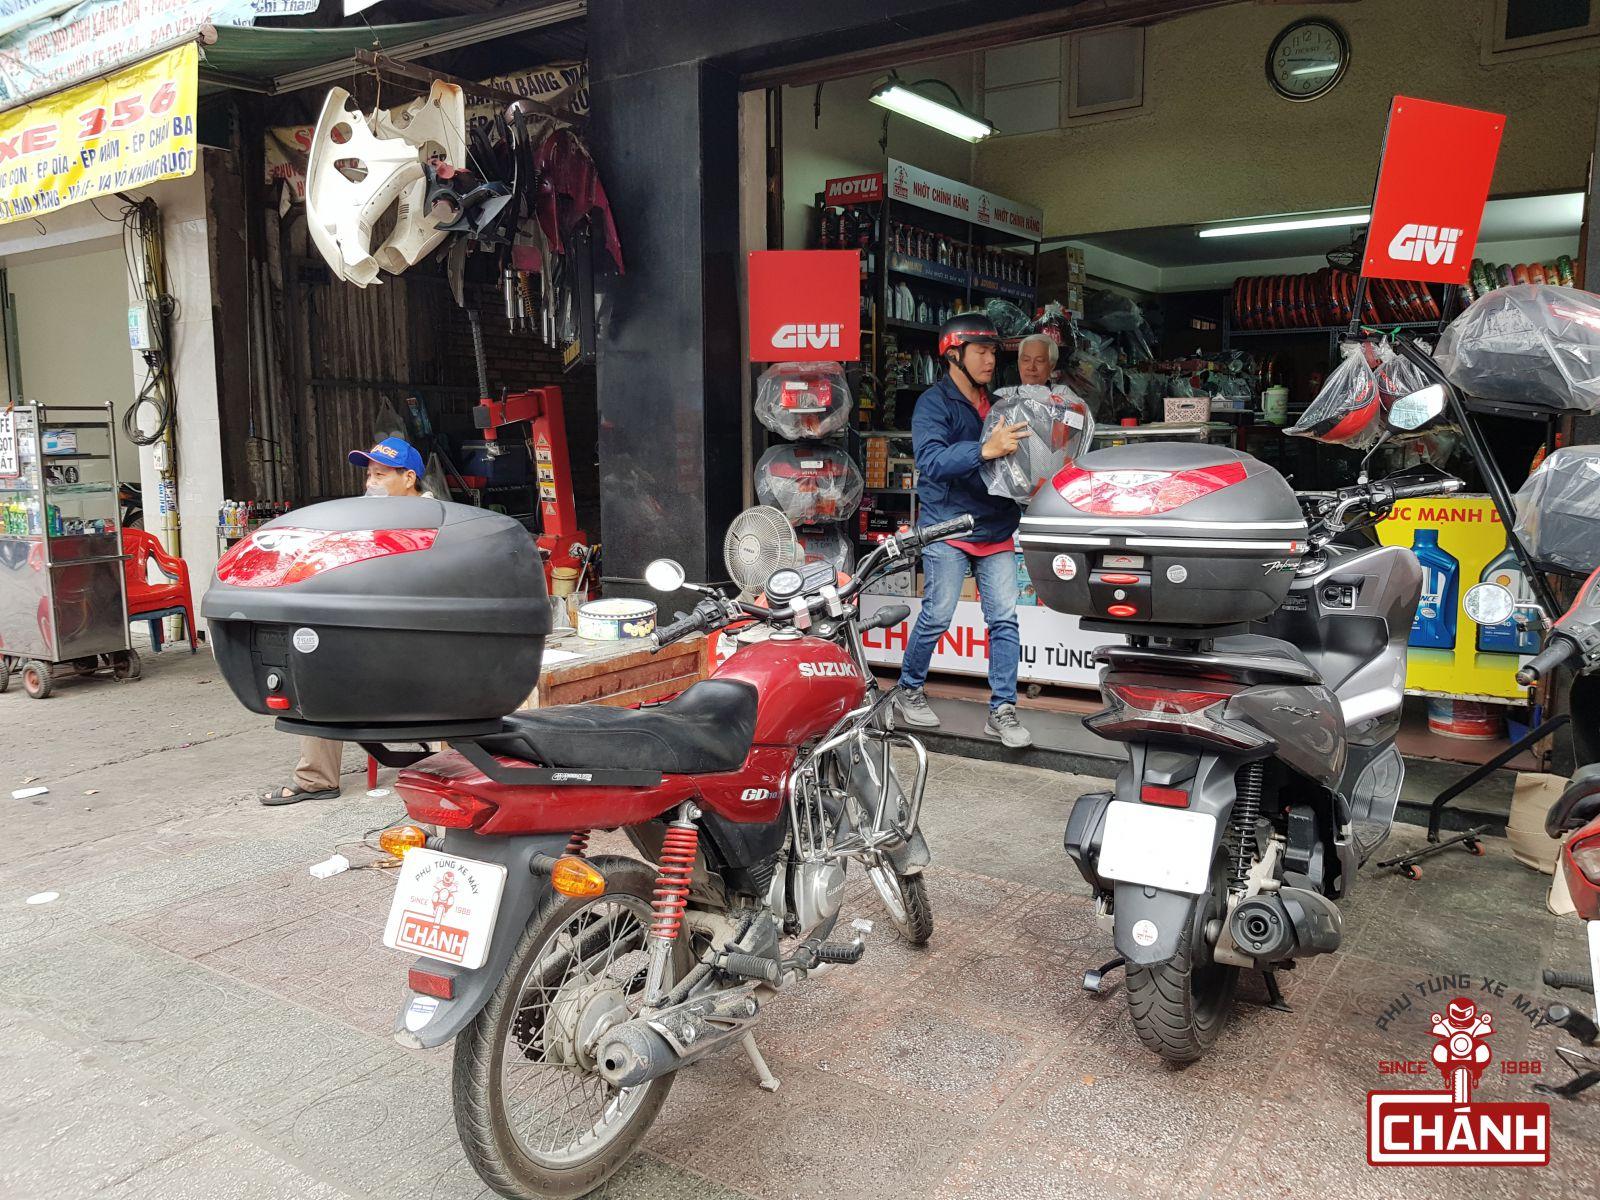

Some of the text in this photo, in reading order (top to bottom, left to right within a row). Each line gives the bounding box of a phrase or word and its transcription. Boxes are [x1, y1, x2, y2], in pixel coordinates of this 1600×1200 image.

[516, 72, 561, 97] BĂNG
[78, 82, 177, 139] 356
[173, 115, 193, 136] BA
[160, 147, 193, 176] RUỘT
[829, 178, 879, 197] MOTUL
[932, 188, 952, 206] CHÍNH
[1387, 223, 1460, 266] GIVI
[771, 323, 841, 350] GIVI
[1418, 507, 1482, 525] MẠNH
[862, 621, 990, 660] CHNH
[1045, 642, 1096, 669] TÙNG
[799, 662, 858, 677] SUZUKI
[458, 864, 469, 876] XE
[402, 922, 467, 955] CHÁNH
